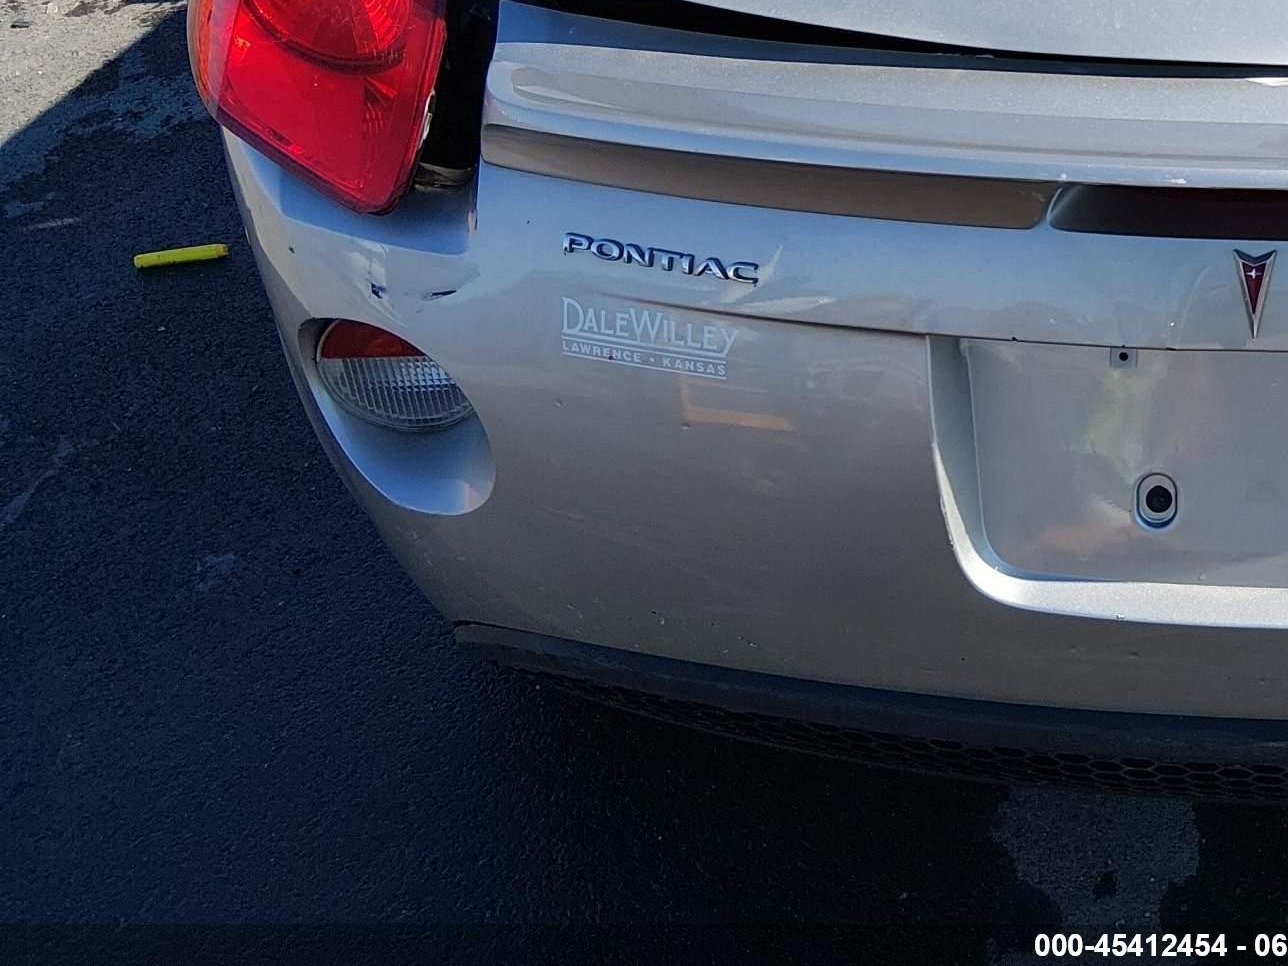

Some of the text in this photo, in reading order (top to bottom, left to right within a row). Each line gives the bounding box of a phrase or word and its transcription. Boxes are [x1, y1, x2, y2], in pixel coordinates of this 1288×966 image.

[562, 232, 760, 284] PONTIAC
[562, 340, 727, 377] LAWRENCE KANSAS
